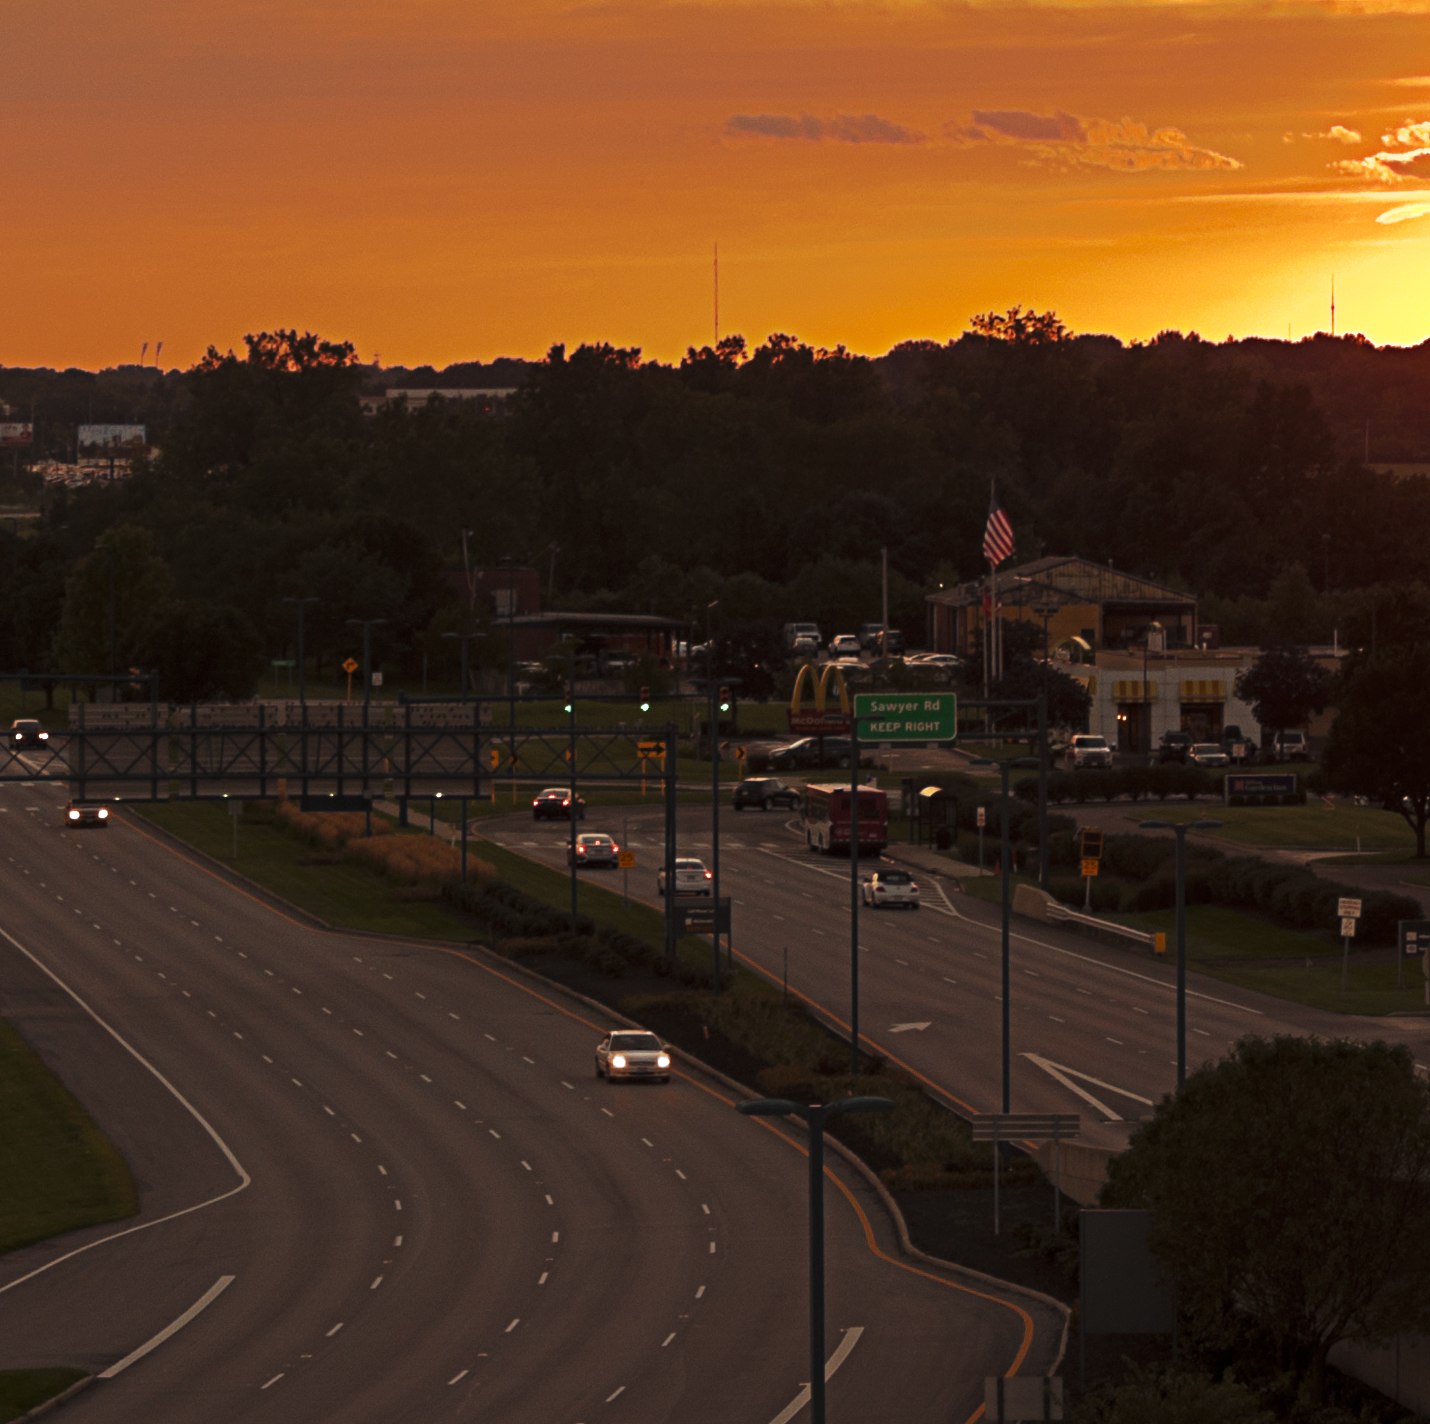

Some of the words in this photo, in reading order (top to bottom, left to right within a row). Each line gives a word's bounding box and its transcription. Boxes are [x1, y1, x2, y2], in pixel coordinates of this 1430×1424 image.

[870, 700, 919, 713] Sawyer
[924, 700, 940, 711] Rd
[870, 722, 901, 732] KEEP
[905, 721, 940, 732] RIGHT
